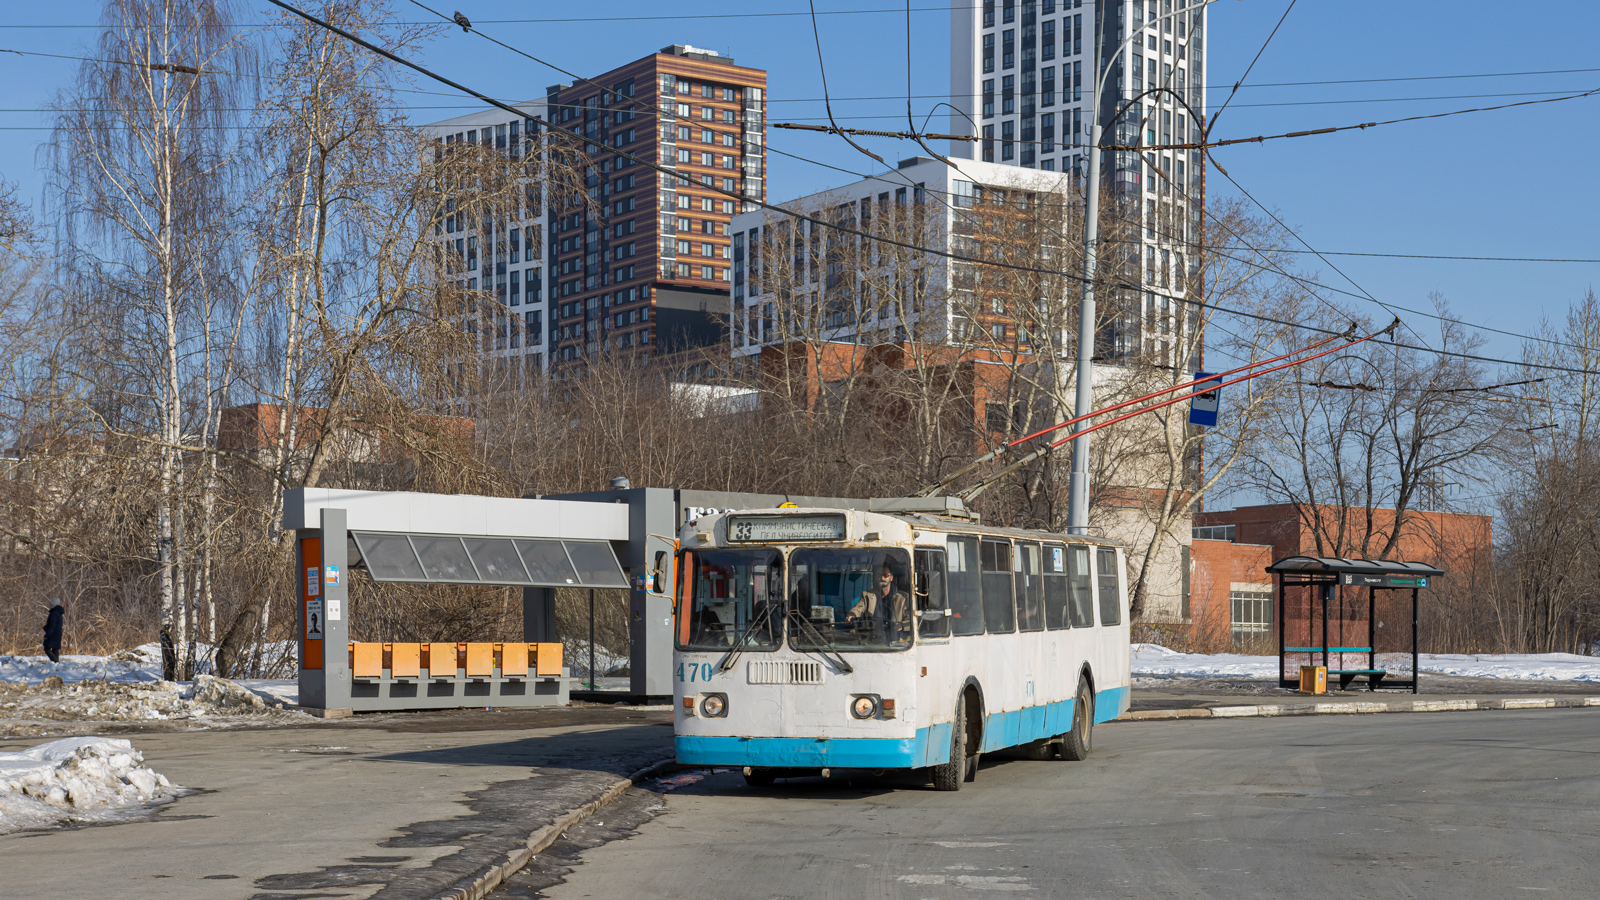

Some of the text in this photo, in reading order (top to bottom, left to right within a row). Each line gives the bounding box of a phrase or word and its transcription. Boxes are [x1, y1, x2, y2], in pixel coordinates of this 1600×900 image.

[735, 521, 752, 540] 33
[753, 521, 839, 531] КОММУНИСТИЧЕСКАЯ
[676, 662, 713, 683] 470
